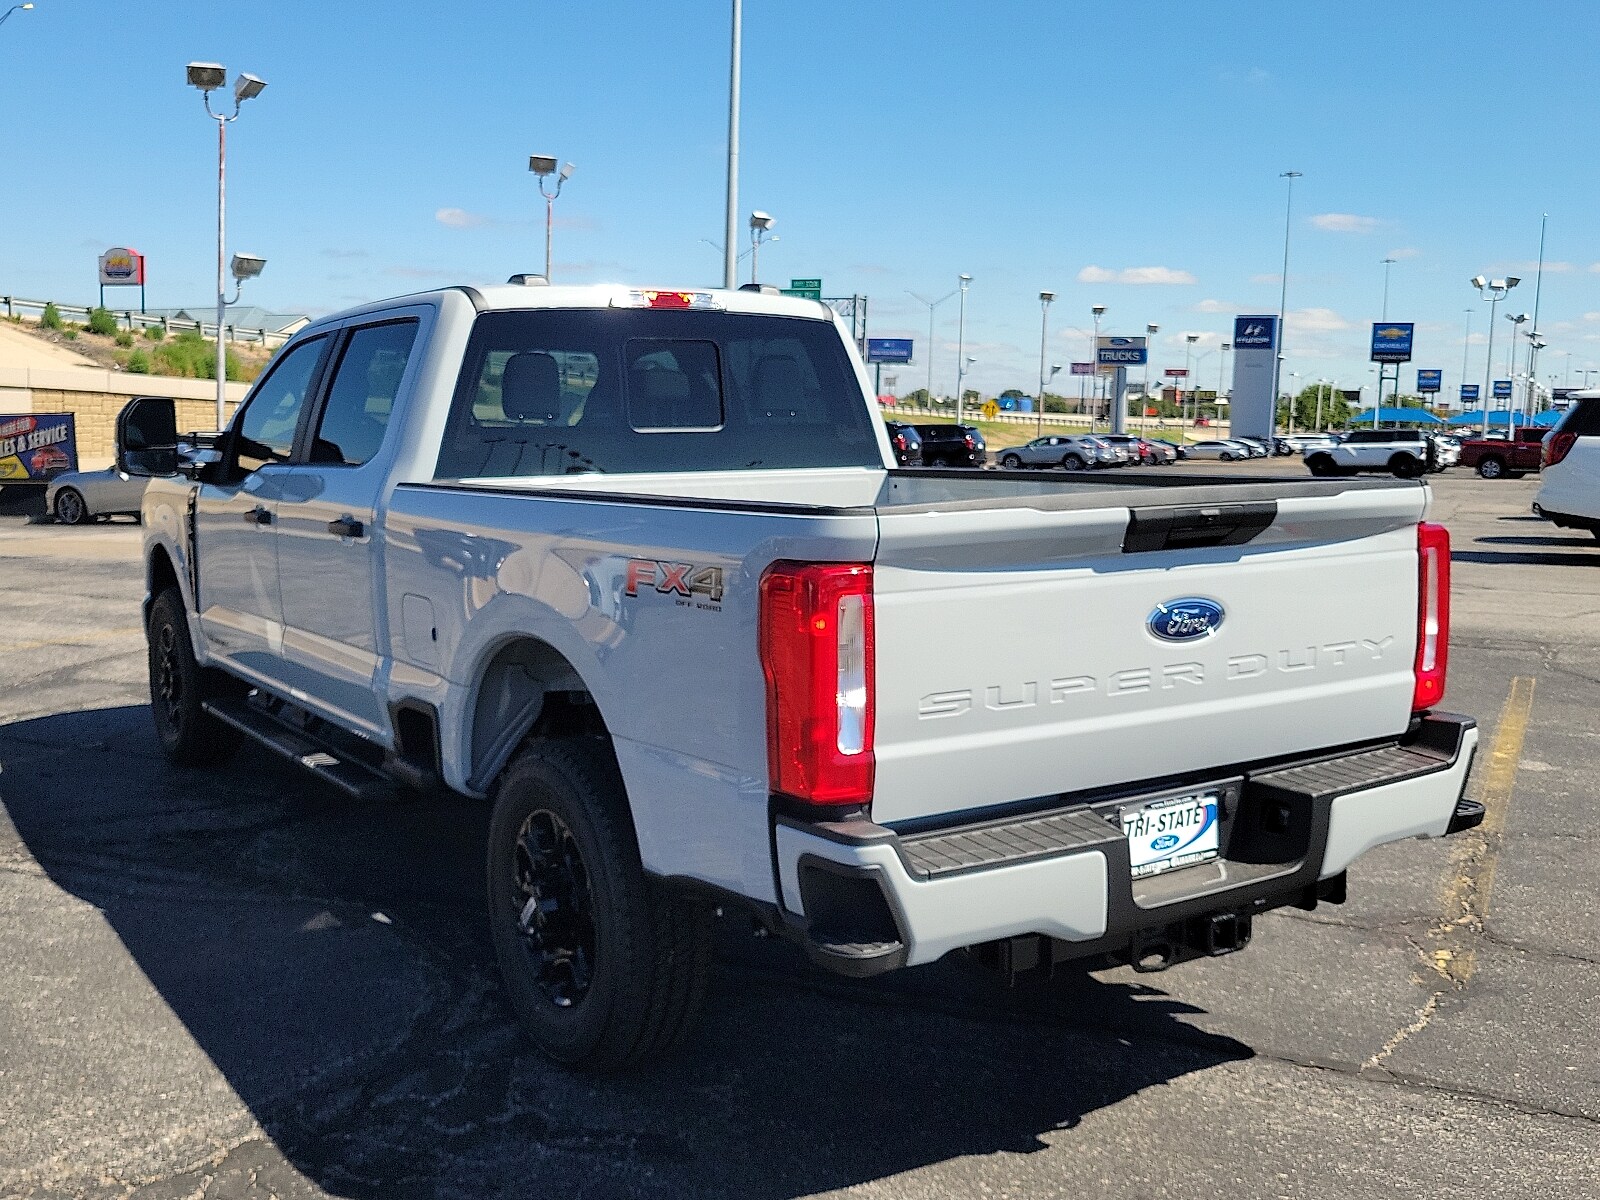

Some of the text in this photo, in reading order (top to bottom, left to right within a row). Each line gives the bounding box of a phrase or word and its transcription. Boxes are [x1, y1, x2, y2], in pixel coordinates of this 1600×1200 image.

[1100, 351, 1141, 361] TRUCKS
[27, 424, 67, 450] SERVICE
[625, 559, 723, 602] FX4
[1166, 608, 1212, 636] Ford
[917, 635, 1396, 721] SUPER DUTY
[1124, 805, 1202, 838] TRI-STATE
